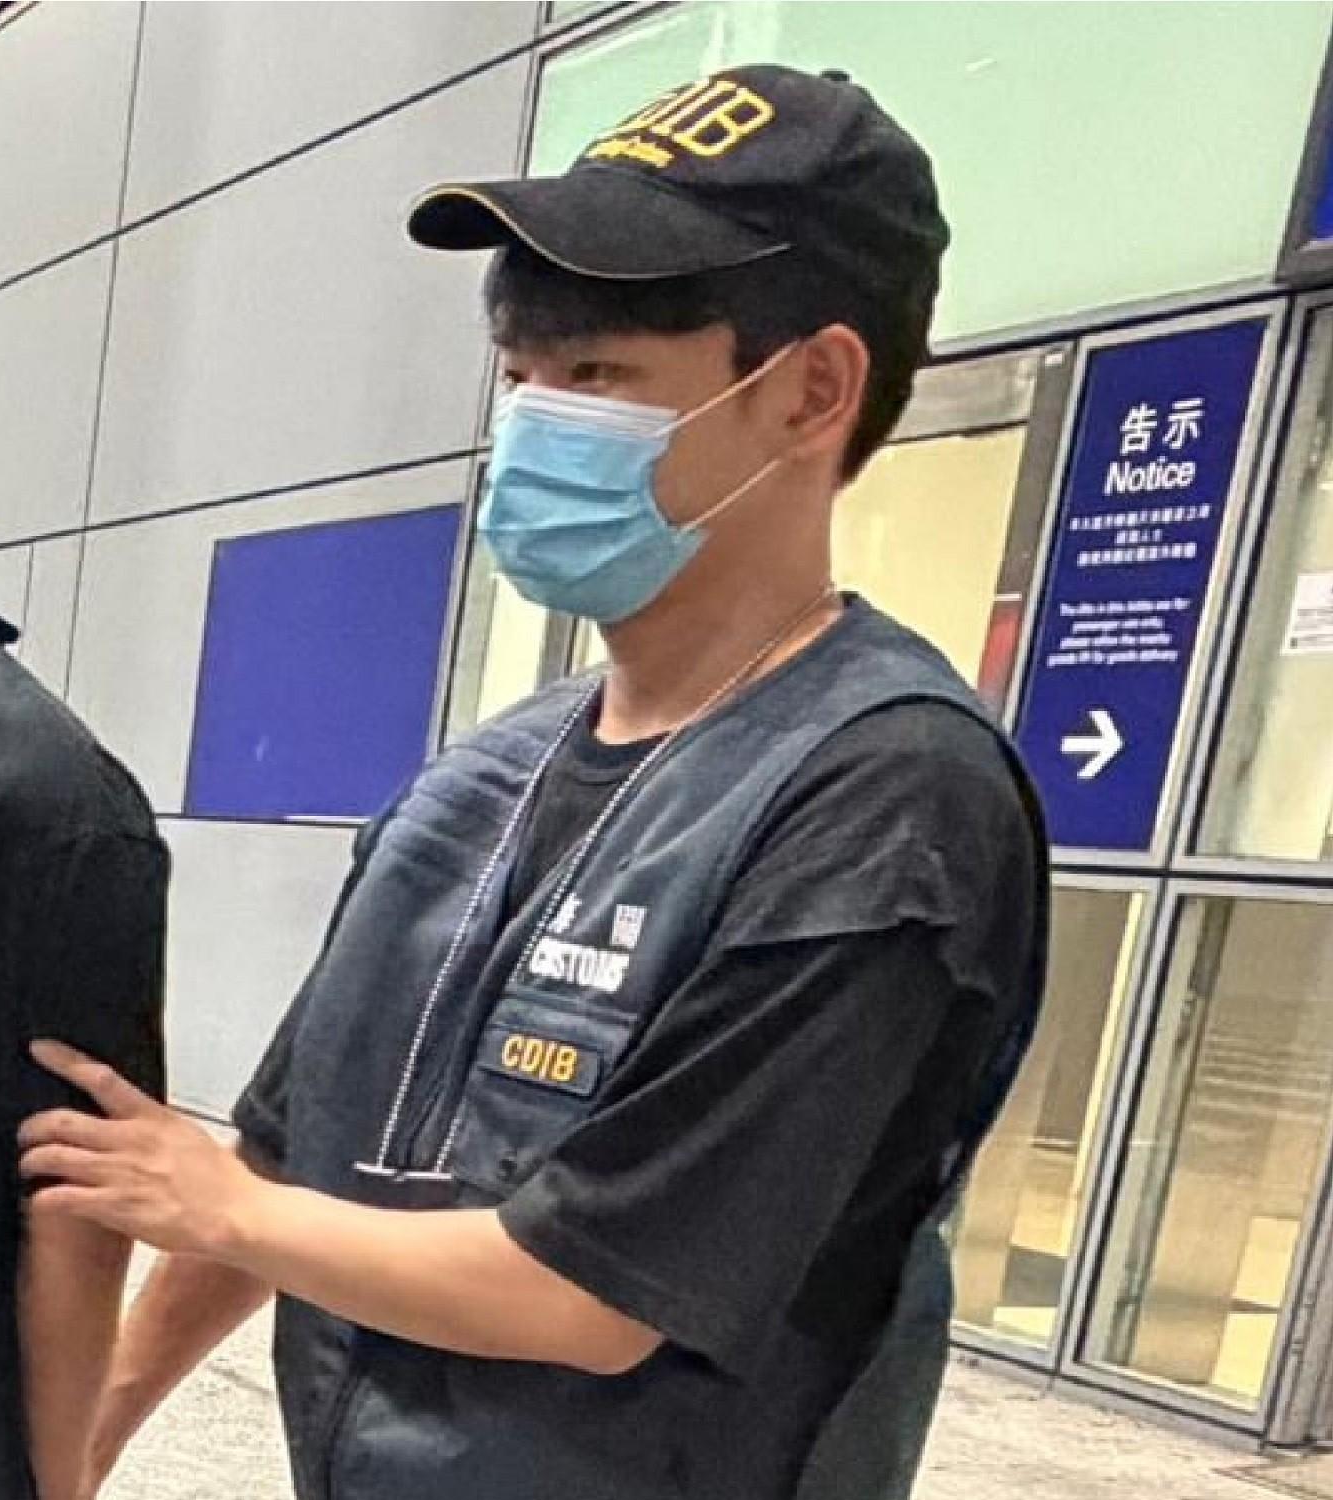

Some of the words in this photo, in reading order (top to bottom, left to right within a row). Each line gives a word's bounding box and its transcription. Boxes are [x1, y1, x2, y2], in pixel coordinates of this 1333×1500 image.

[1119, 397, 1206, 456] 告示
[1104, 455, 1196, 496] Notice
[501, 1033, 578, 1082] CDIB
